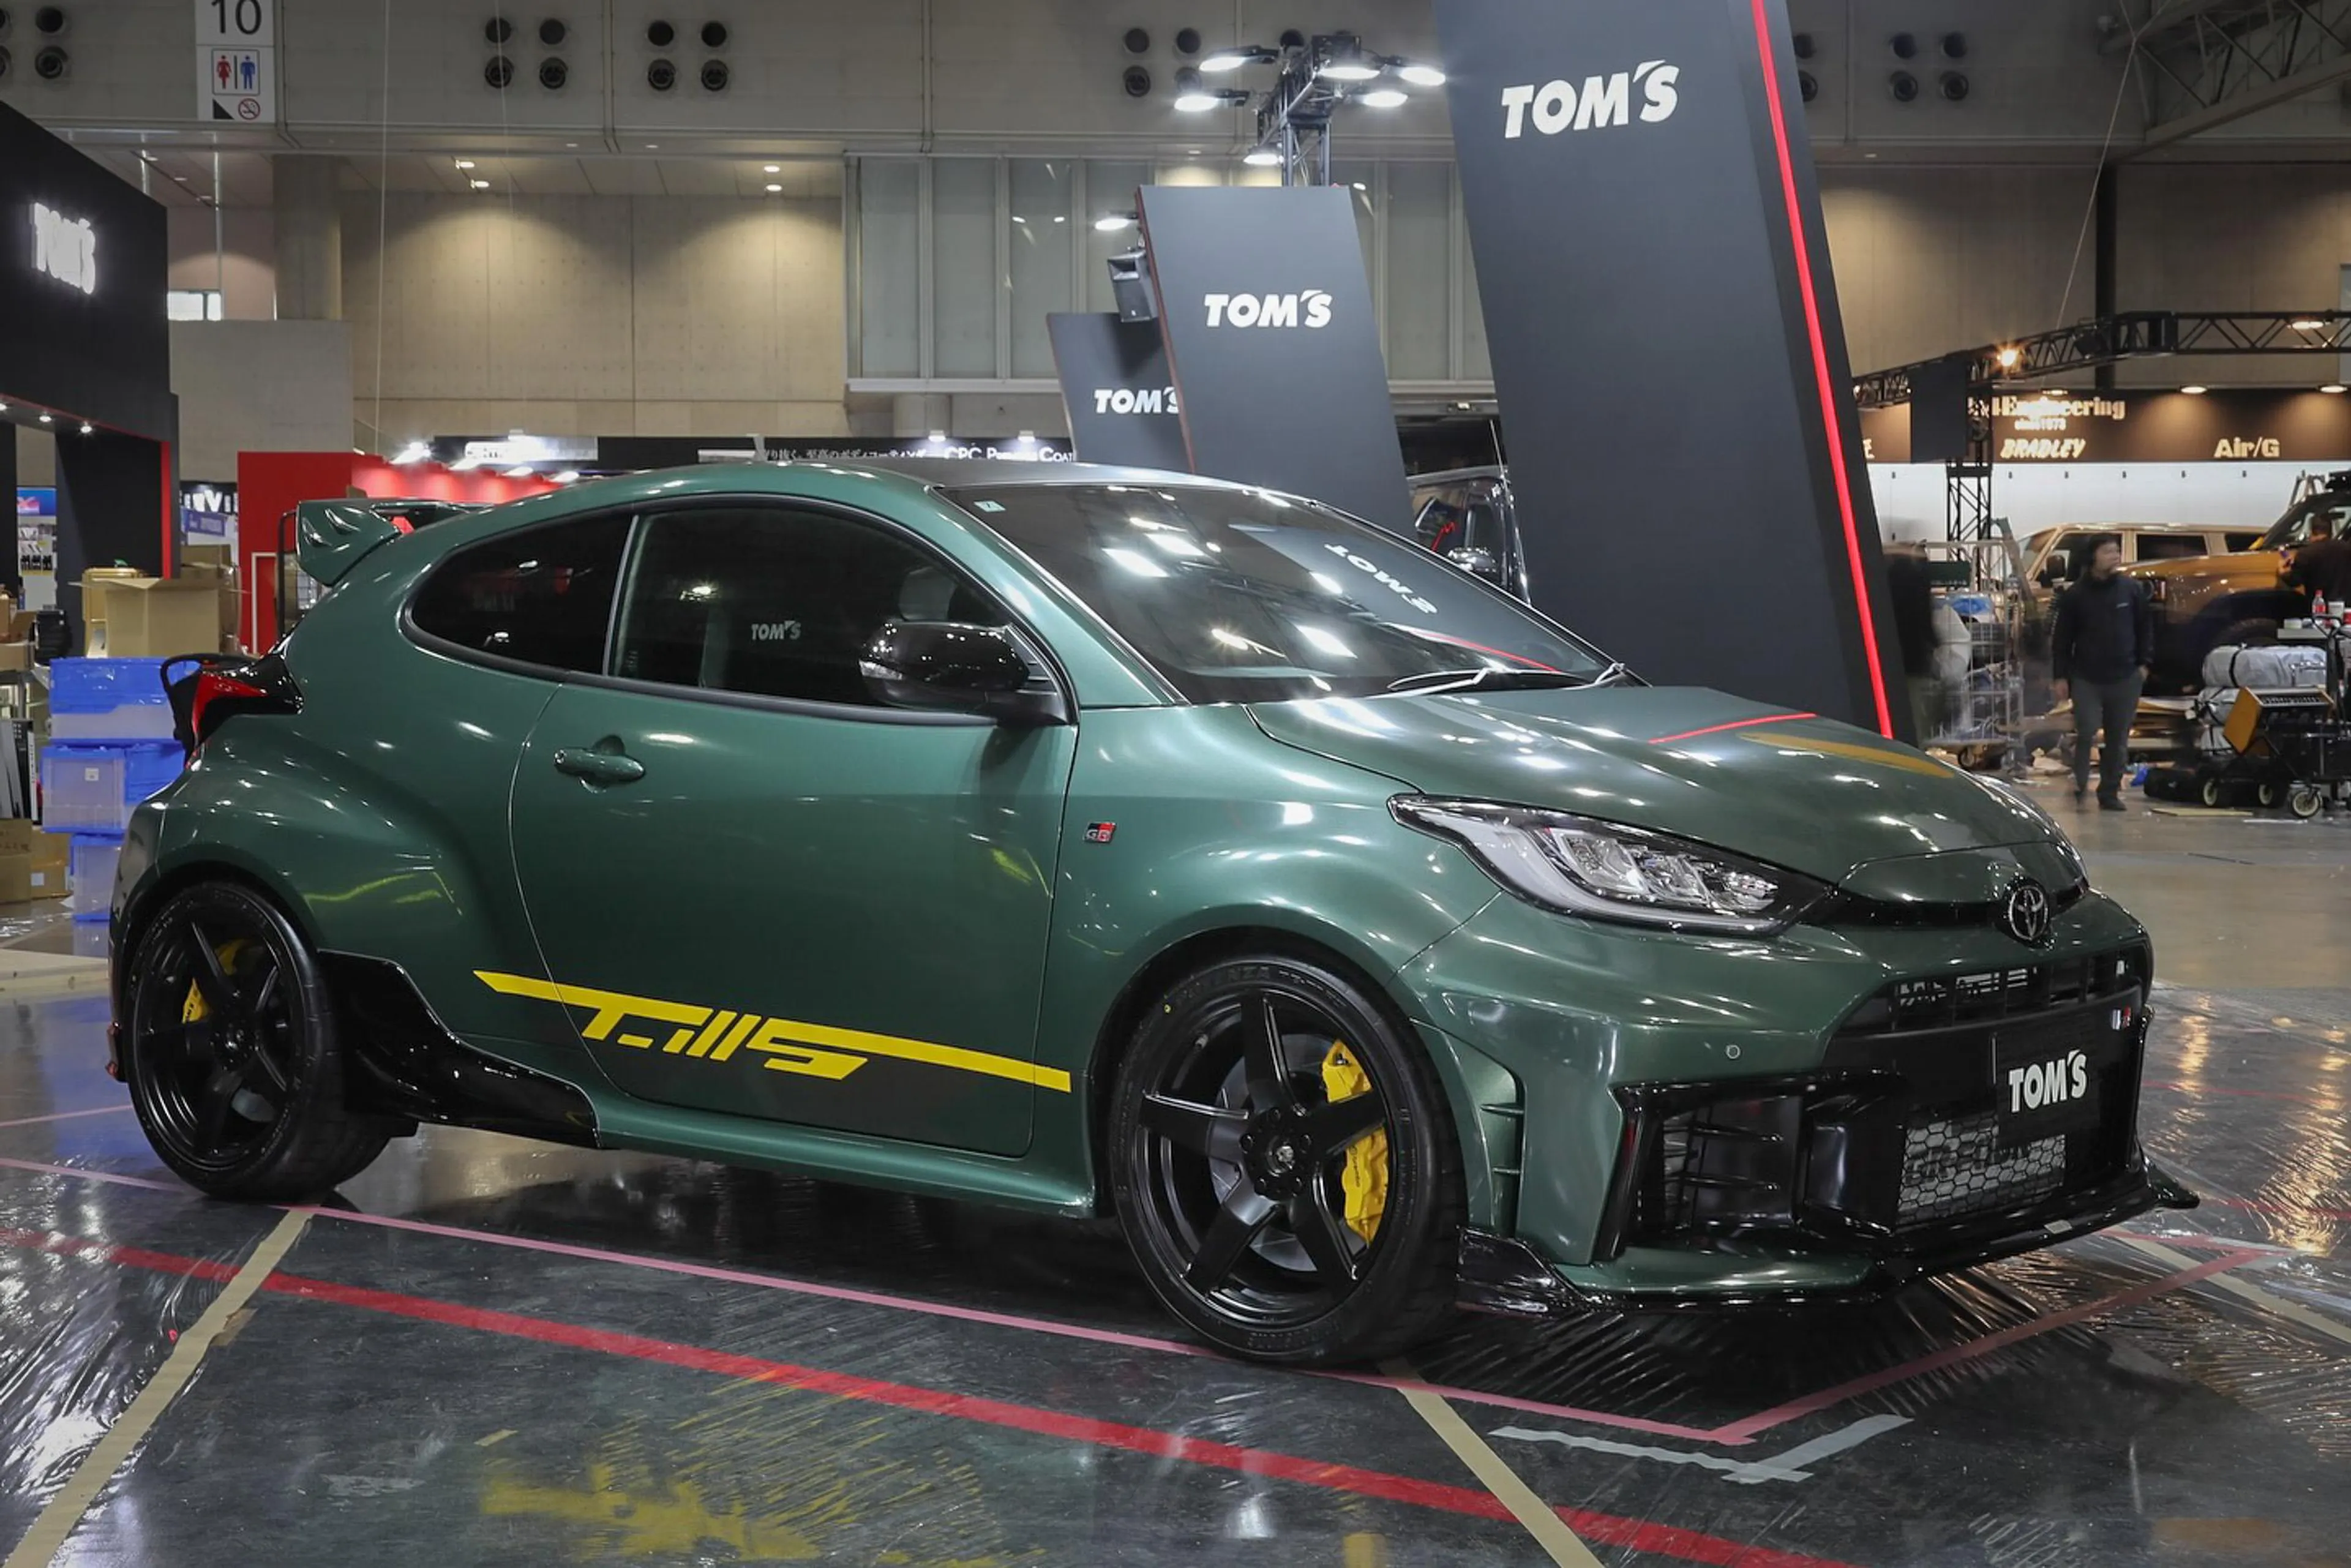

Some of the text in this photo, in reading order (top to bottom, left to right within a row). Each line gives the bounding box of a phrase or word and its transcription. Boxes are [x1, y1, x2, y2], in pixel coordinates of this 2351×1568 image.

[211, 0, 262, 35] 10
[1502, 59, 1680, 138] TOM'S
[1204, 290, 1333, 328] TOM'S
[2000, 438, 2087, 459] BRADLEY
[2213, 436, 2281, 458] Air/G
[751, 620, 802, 640] TOM'S
[2009, 1048, 2088, 1113] TOM'S
